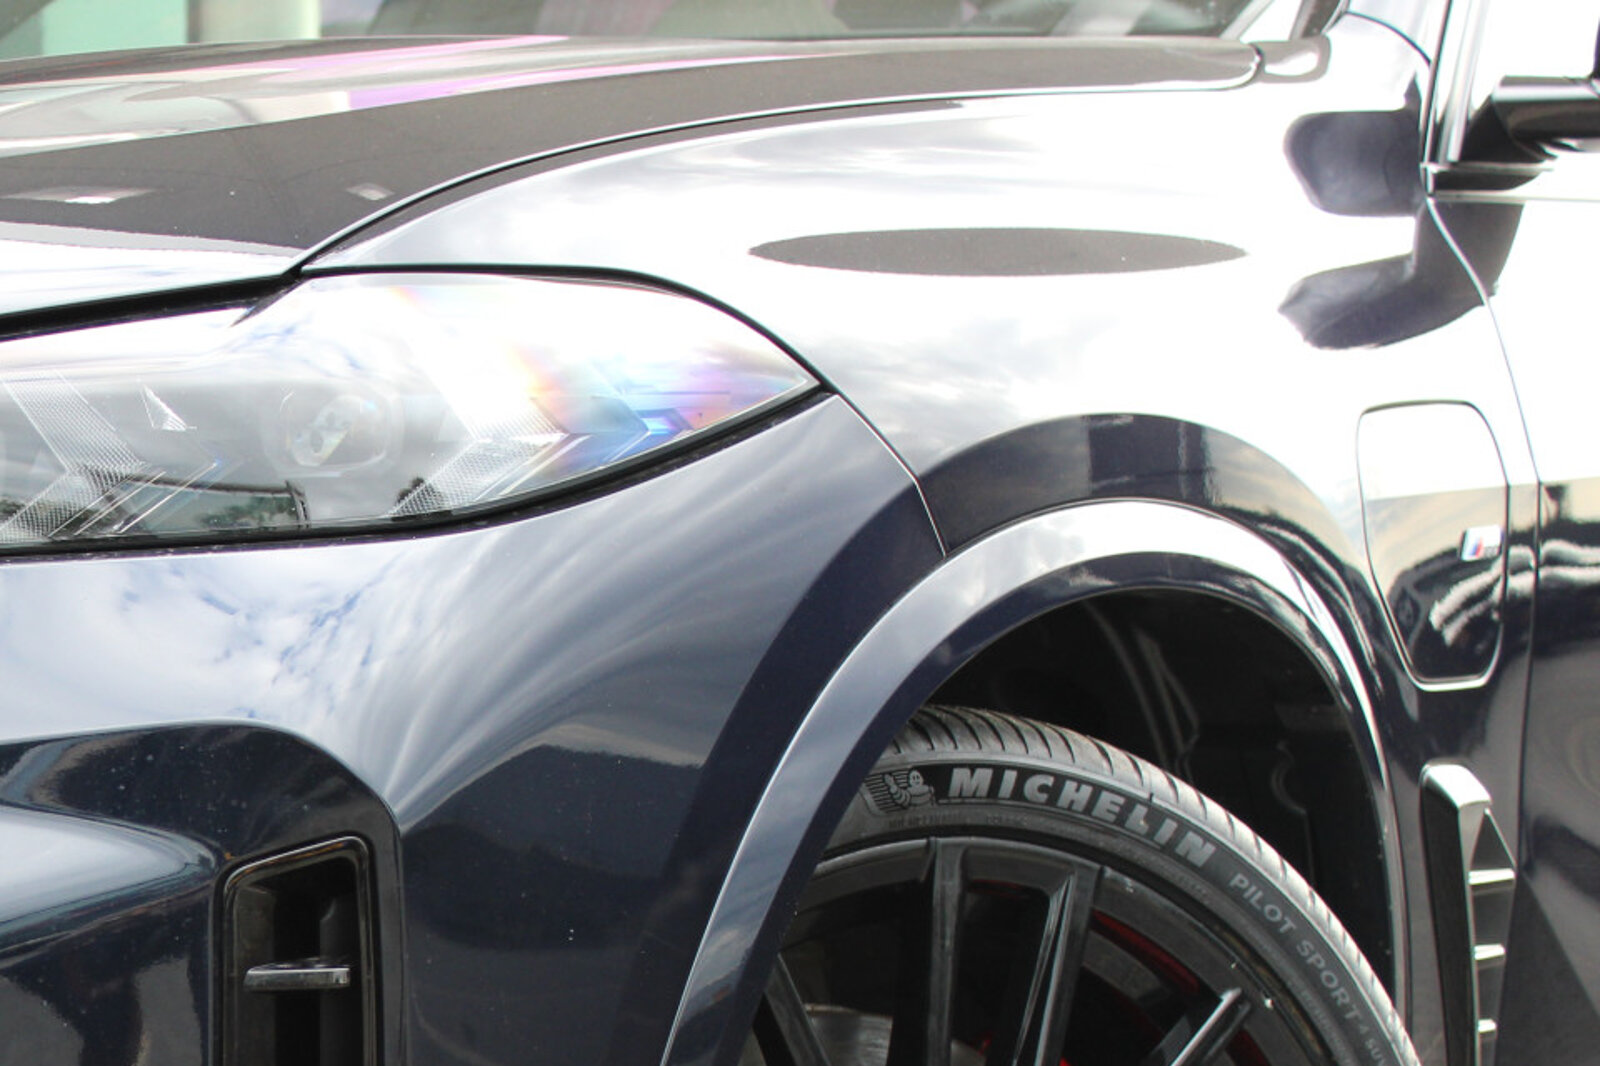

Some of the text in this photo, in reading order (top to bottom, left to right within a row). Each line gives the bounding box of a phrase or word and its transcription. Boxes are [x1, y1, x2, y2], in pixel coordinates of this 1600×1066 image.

[949, 767, 1215, 867] MICHELIN
[1230, 873, 1296, 935] PILOT
[1298, 939, 1360, 1021] SPORT
